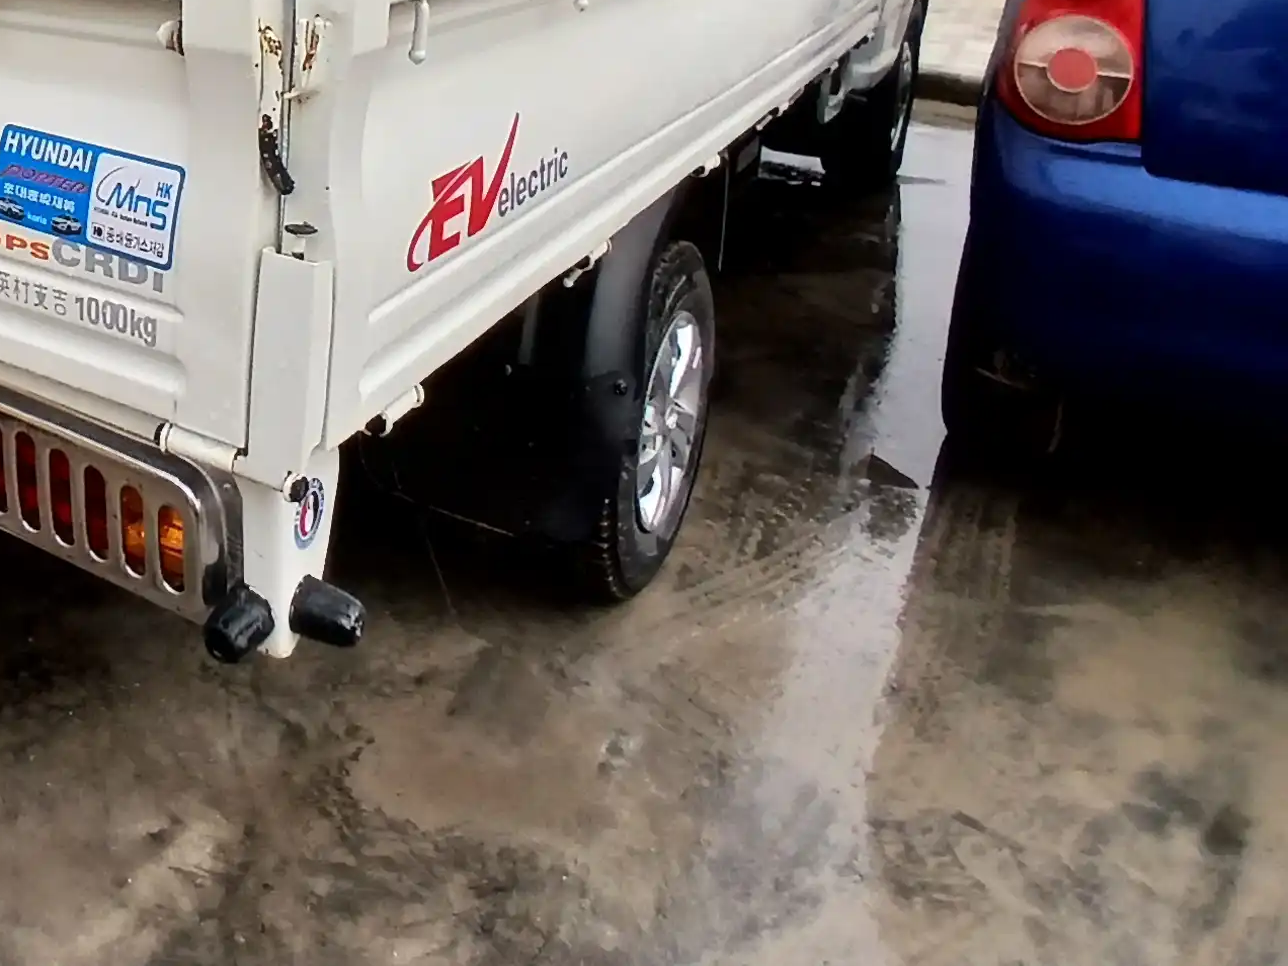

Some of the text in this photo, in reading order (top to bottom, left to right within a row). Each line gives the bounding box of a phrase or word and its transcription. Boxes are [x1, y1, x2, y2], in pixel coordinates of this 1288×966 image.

[3, 129, 93, 174] HYUNDAI
[155, 180, 174, 201] HK
[497, 146, 569, 218] electric
[74, 296, 158, 348] 1000kg
